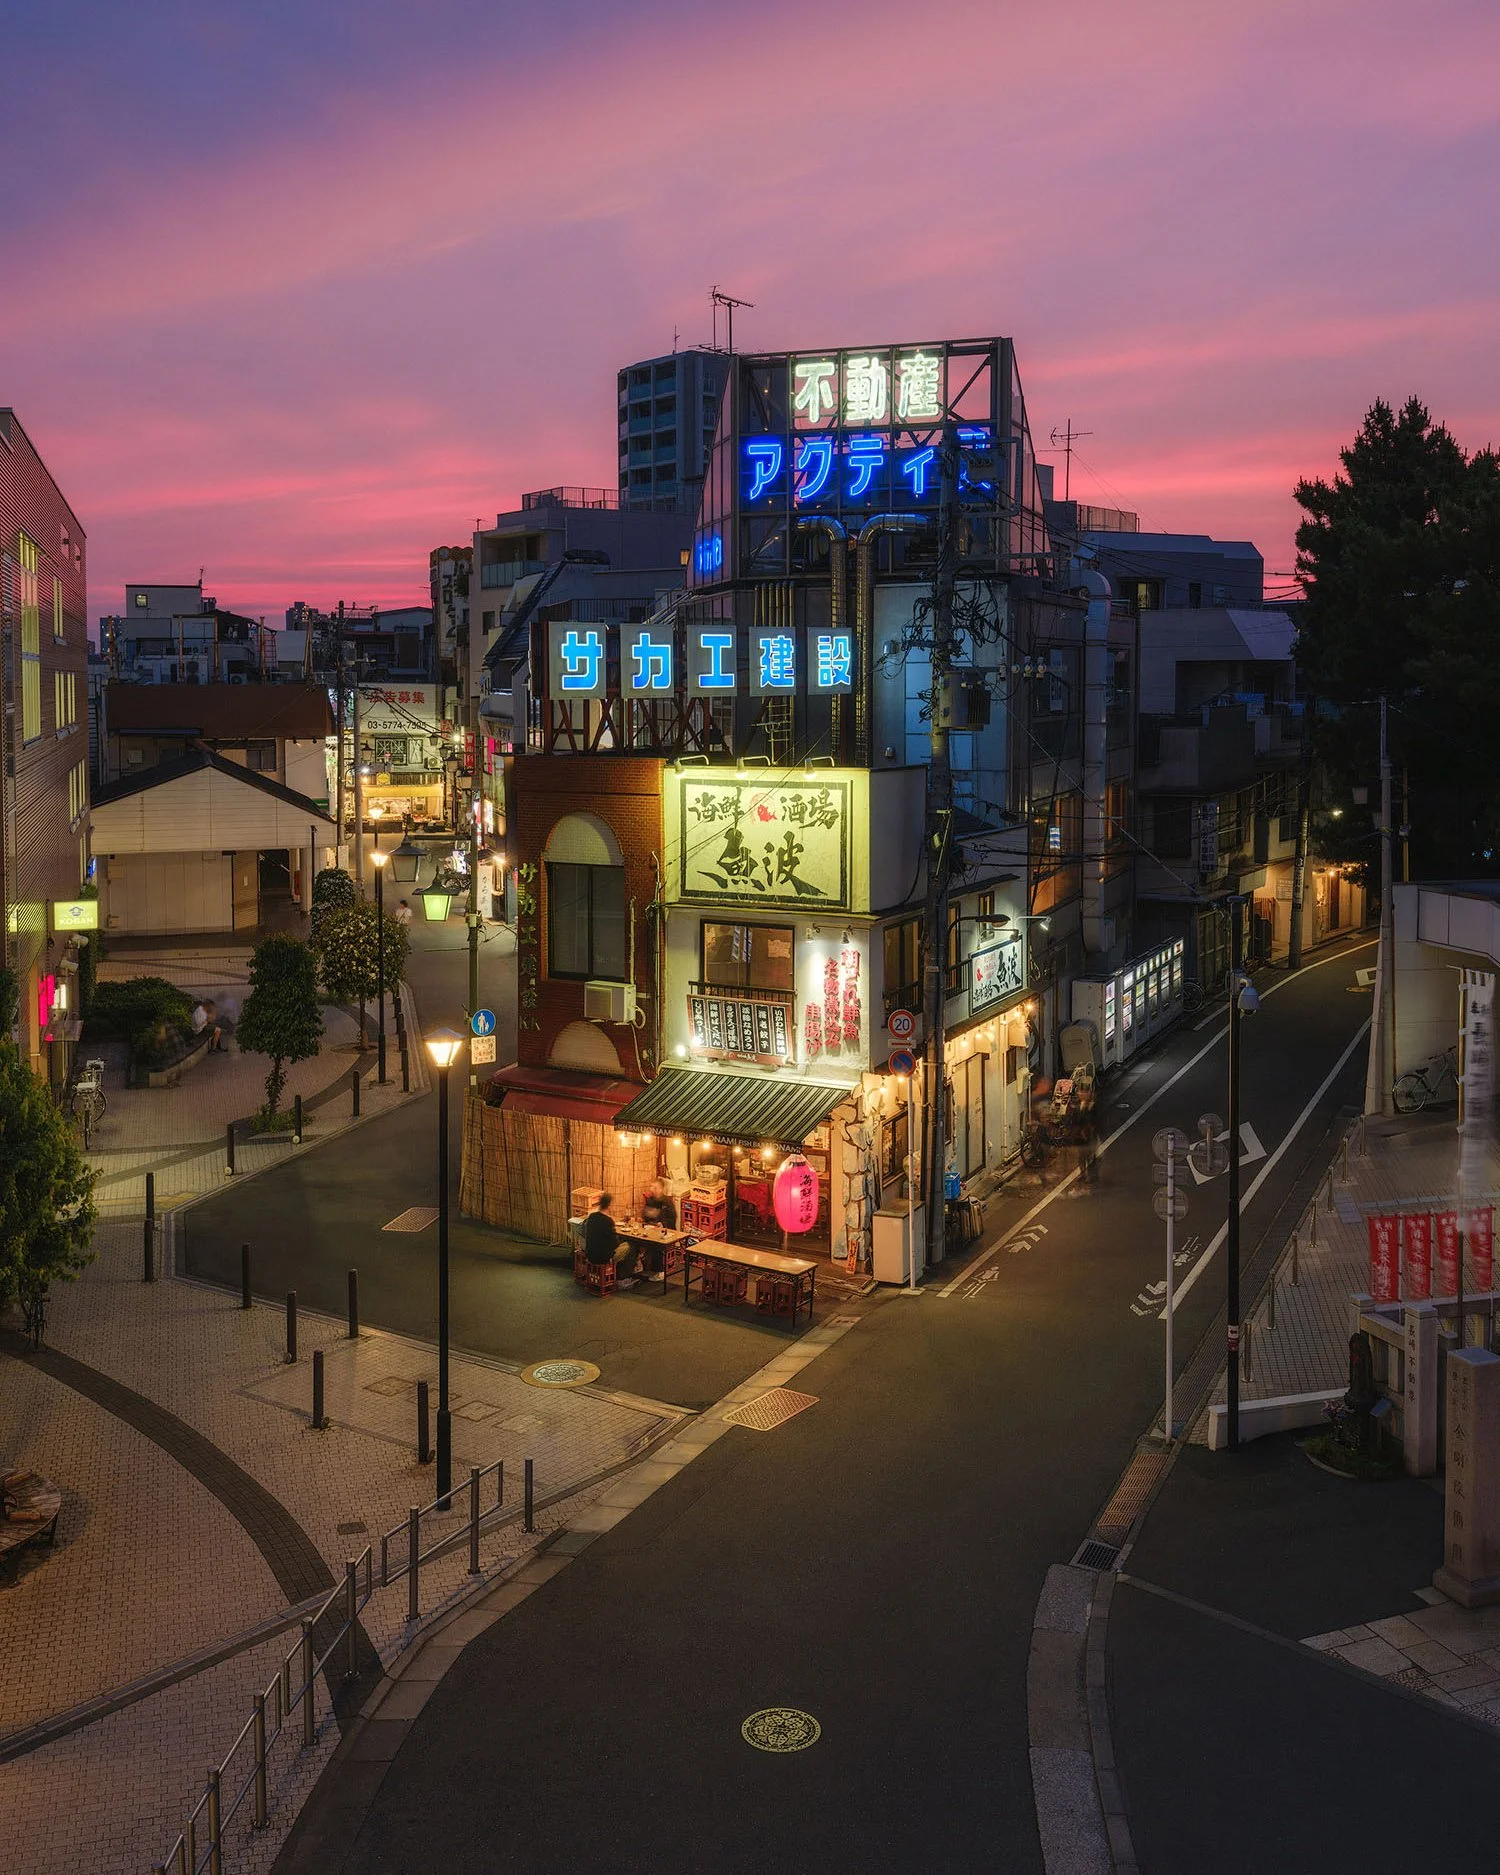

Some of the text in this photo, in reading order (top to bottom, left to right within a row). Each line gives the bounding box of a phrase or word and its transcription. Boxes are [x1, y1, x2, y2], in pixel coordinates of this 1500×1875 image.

[794, 353, 940, 422] 不動産
[561, 631, 850, 690] サカエ建設
[688, 786, 840, 830] 海鮮 酒場
[895, 1018, 910, 1031] 20
